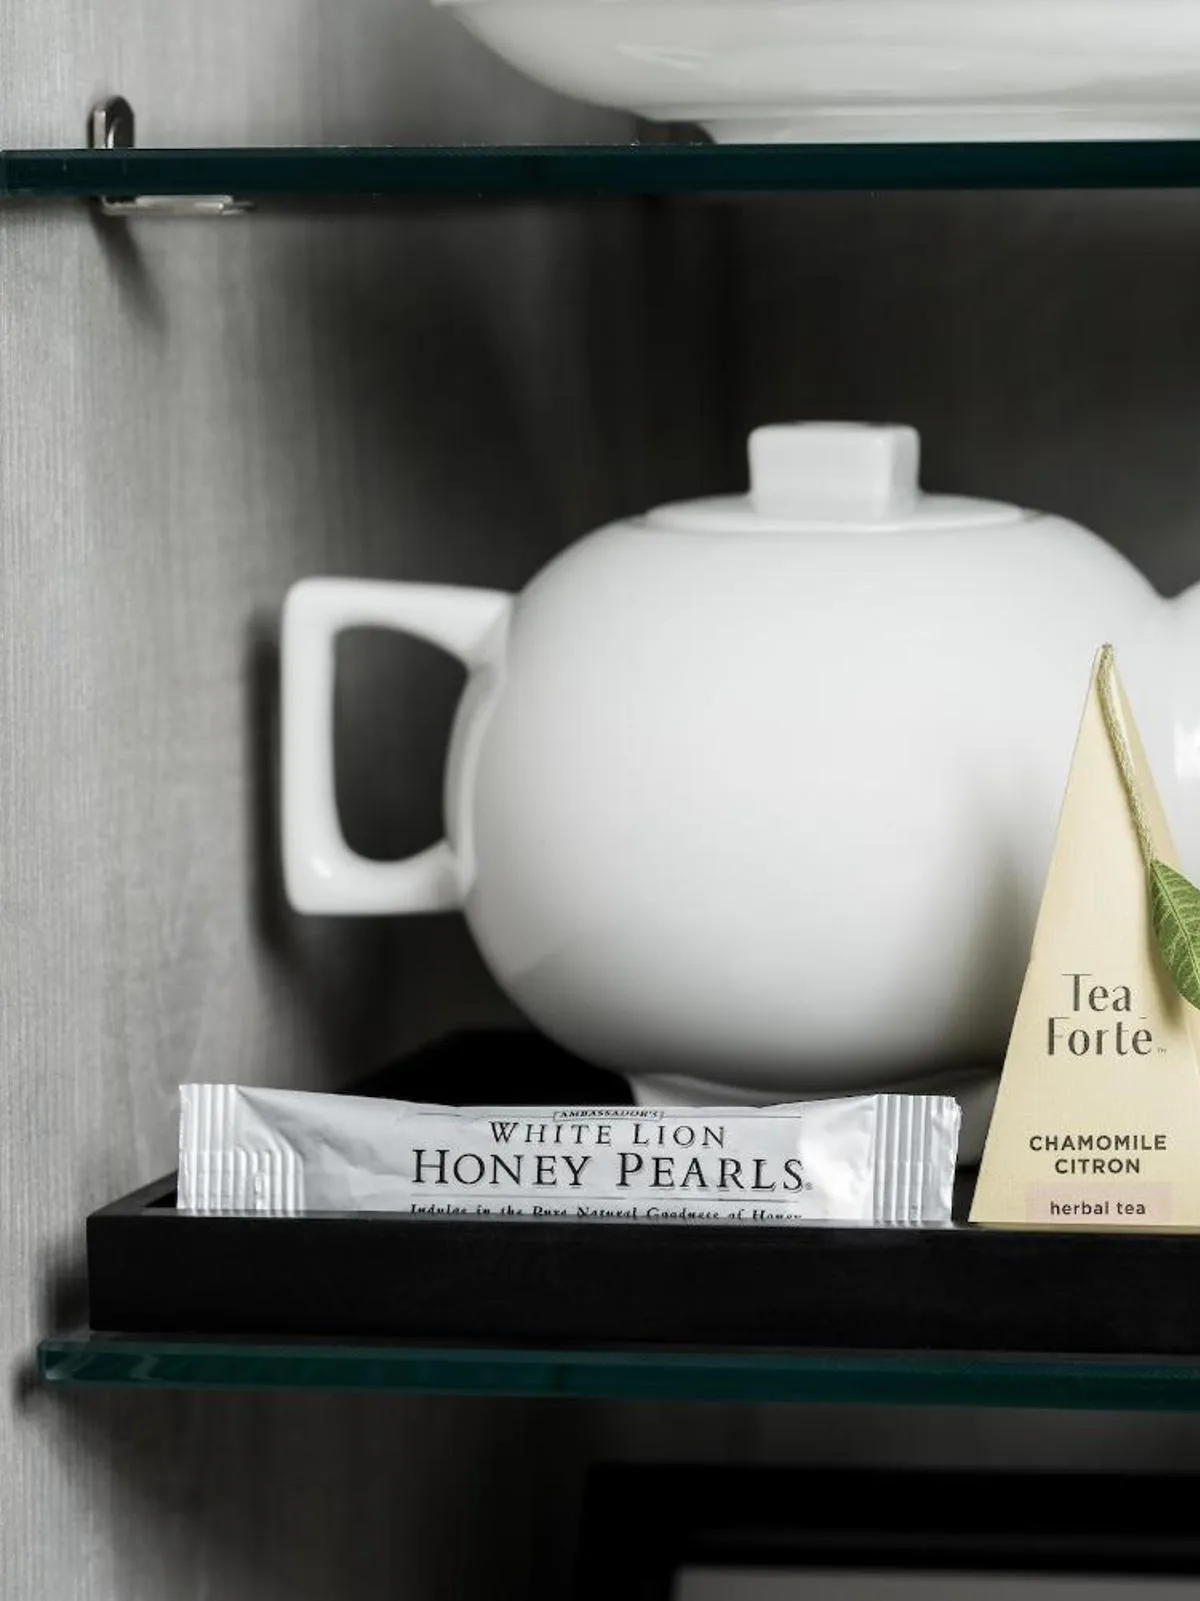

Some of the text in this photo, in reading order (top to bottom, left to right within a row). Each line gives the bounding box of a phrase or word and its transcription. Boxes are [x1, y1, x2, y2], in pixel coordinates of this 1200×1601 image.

[1061, 973, 1131, 1012] Tea
[490, 1120, 725, 1148] WHITE LION
[1029, 1135, 1167, 1151] CHAMOMILE
[412, 1149, 805, 1191] HONEY PEARLS
[1055, 1158, 1140, 1174] CITRON
[1050, 1201, 1146, 1215] herbal tea
